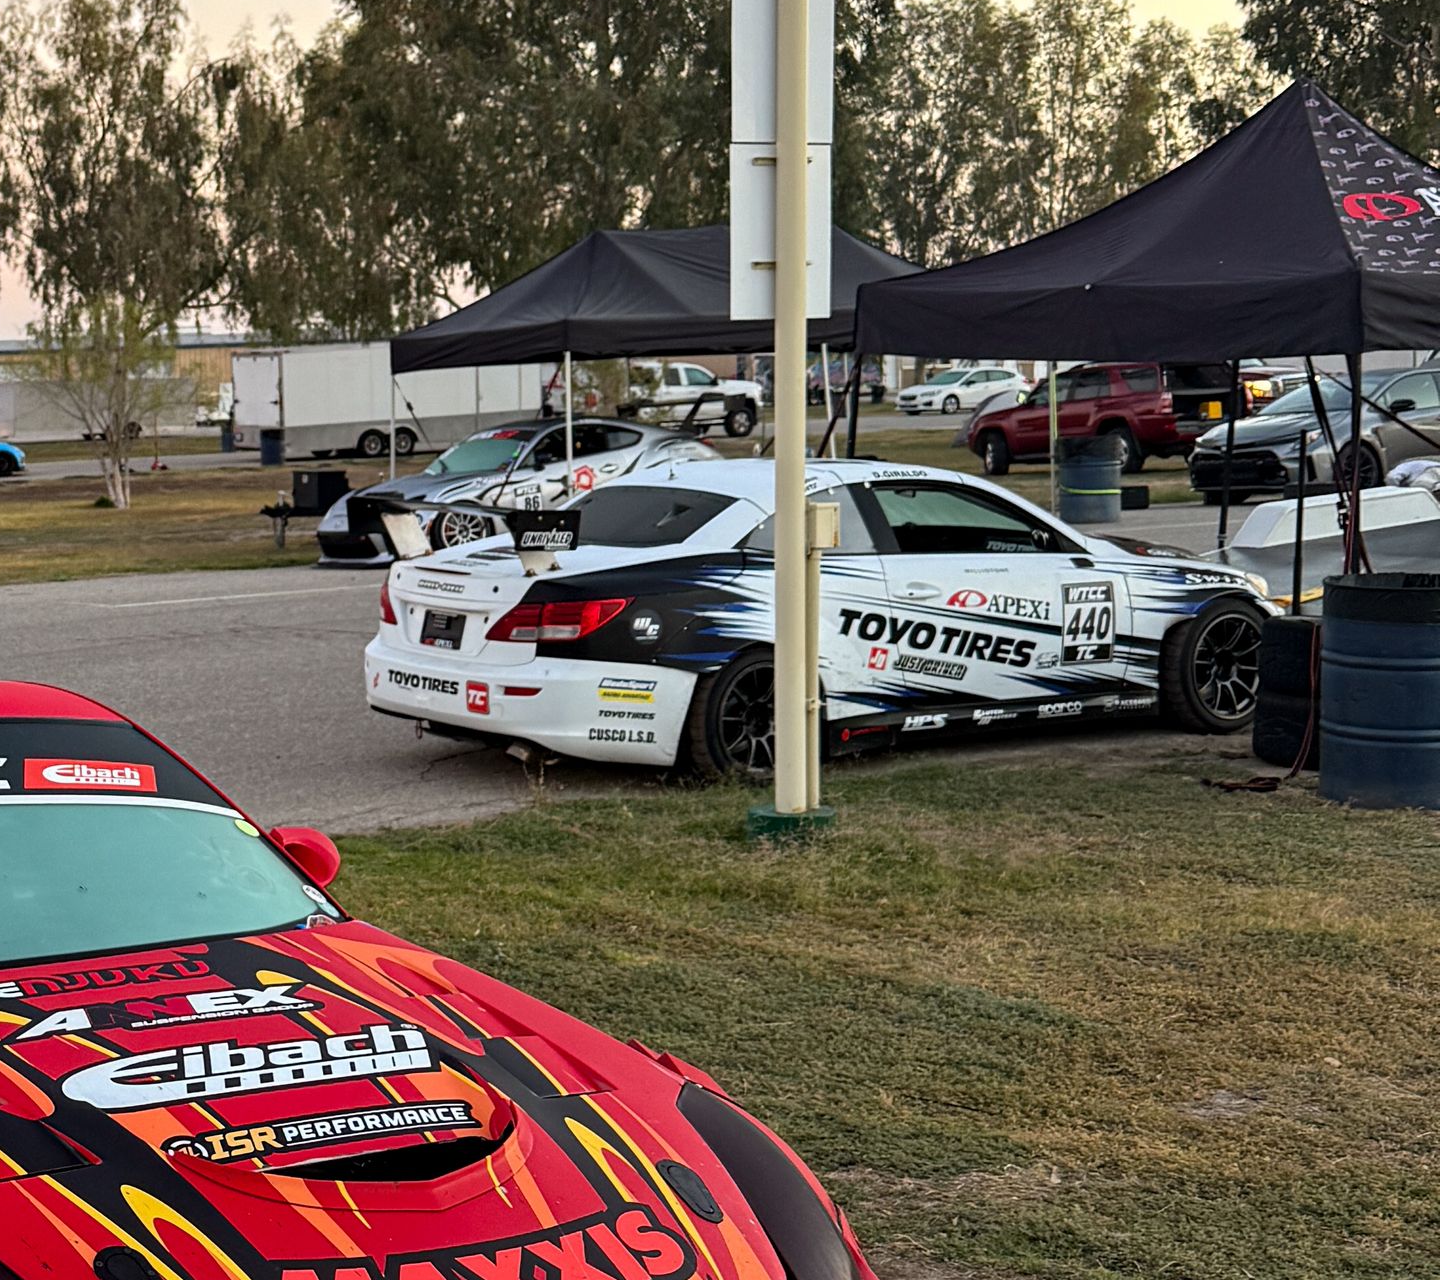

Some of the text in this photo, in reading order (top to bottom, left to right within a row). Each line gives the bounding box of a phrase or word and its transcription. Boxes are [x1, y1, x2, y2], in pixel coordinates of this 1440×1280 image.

[525, 495, 541, 510] 86
[521, 528, 573, 547] UNRIVALED
[1068, 585, 1107, 601] WTCC
[1066, 606, 1110, 642] 440
[1075, 646, 1099, 661] TC
[894, 654, 924, 673] JUST
[467, 688, 488, 706] TC
[902, 713, 949, 730] HPS
[589, 728, 626, 742] CUSCO
[41, 763, 141, 786] Eibach
[131, 1001, 315, 1028] SUSPENSION GROUP
[62, 1025, 431, 1108] Eibach
[209, 1106, 470, 1162] ISR PERFORMANCE
